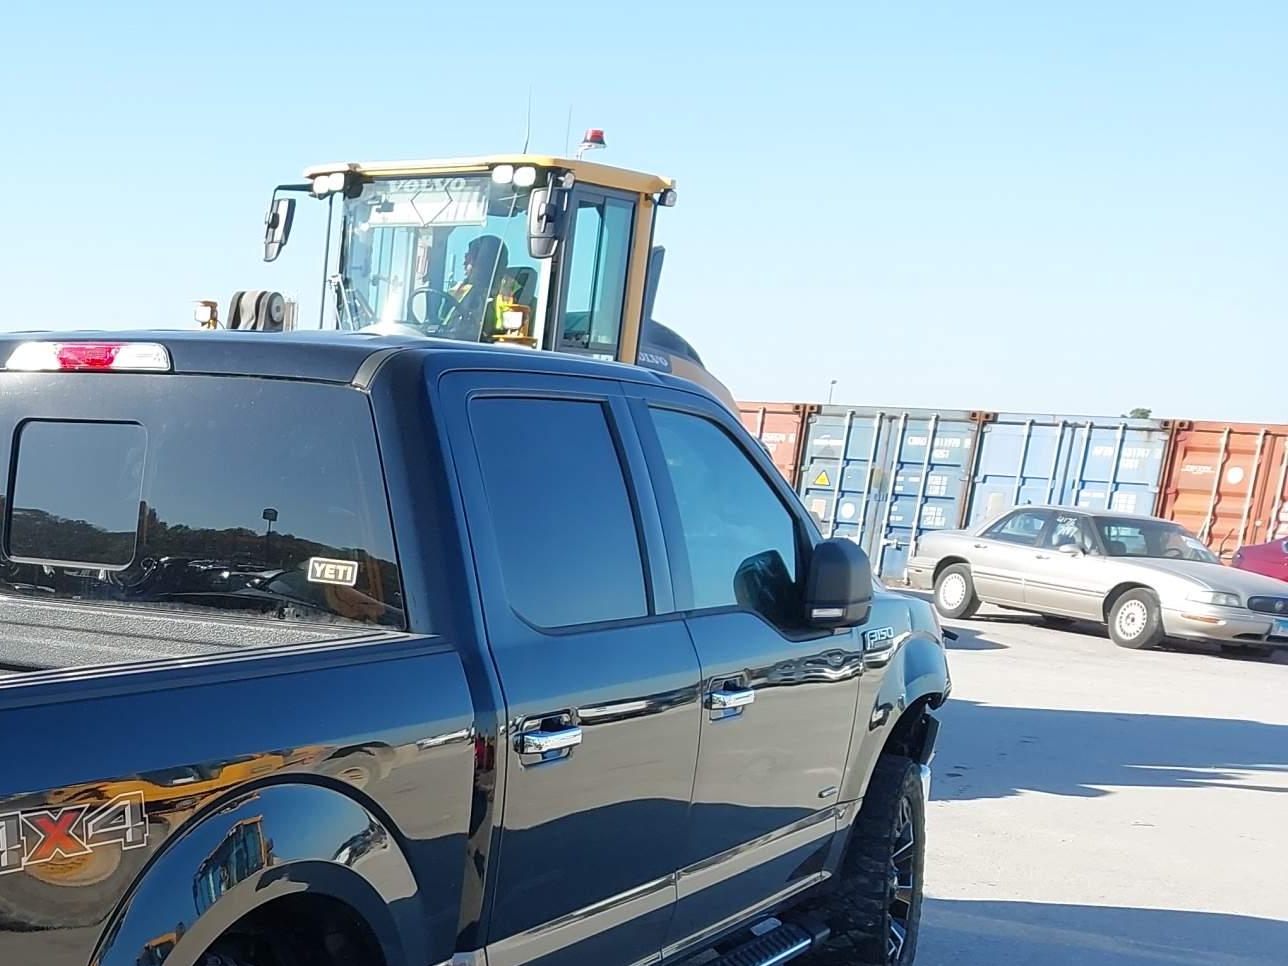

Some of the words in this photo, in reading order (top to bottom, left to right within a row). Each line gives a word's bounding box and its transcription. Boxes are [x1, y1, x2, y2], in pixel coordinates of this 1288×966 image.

[392, 177, 466, 191] VOLVO
[638, 351, 669, 367] OLVO
[313, 562, 353, 581] YETI
